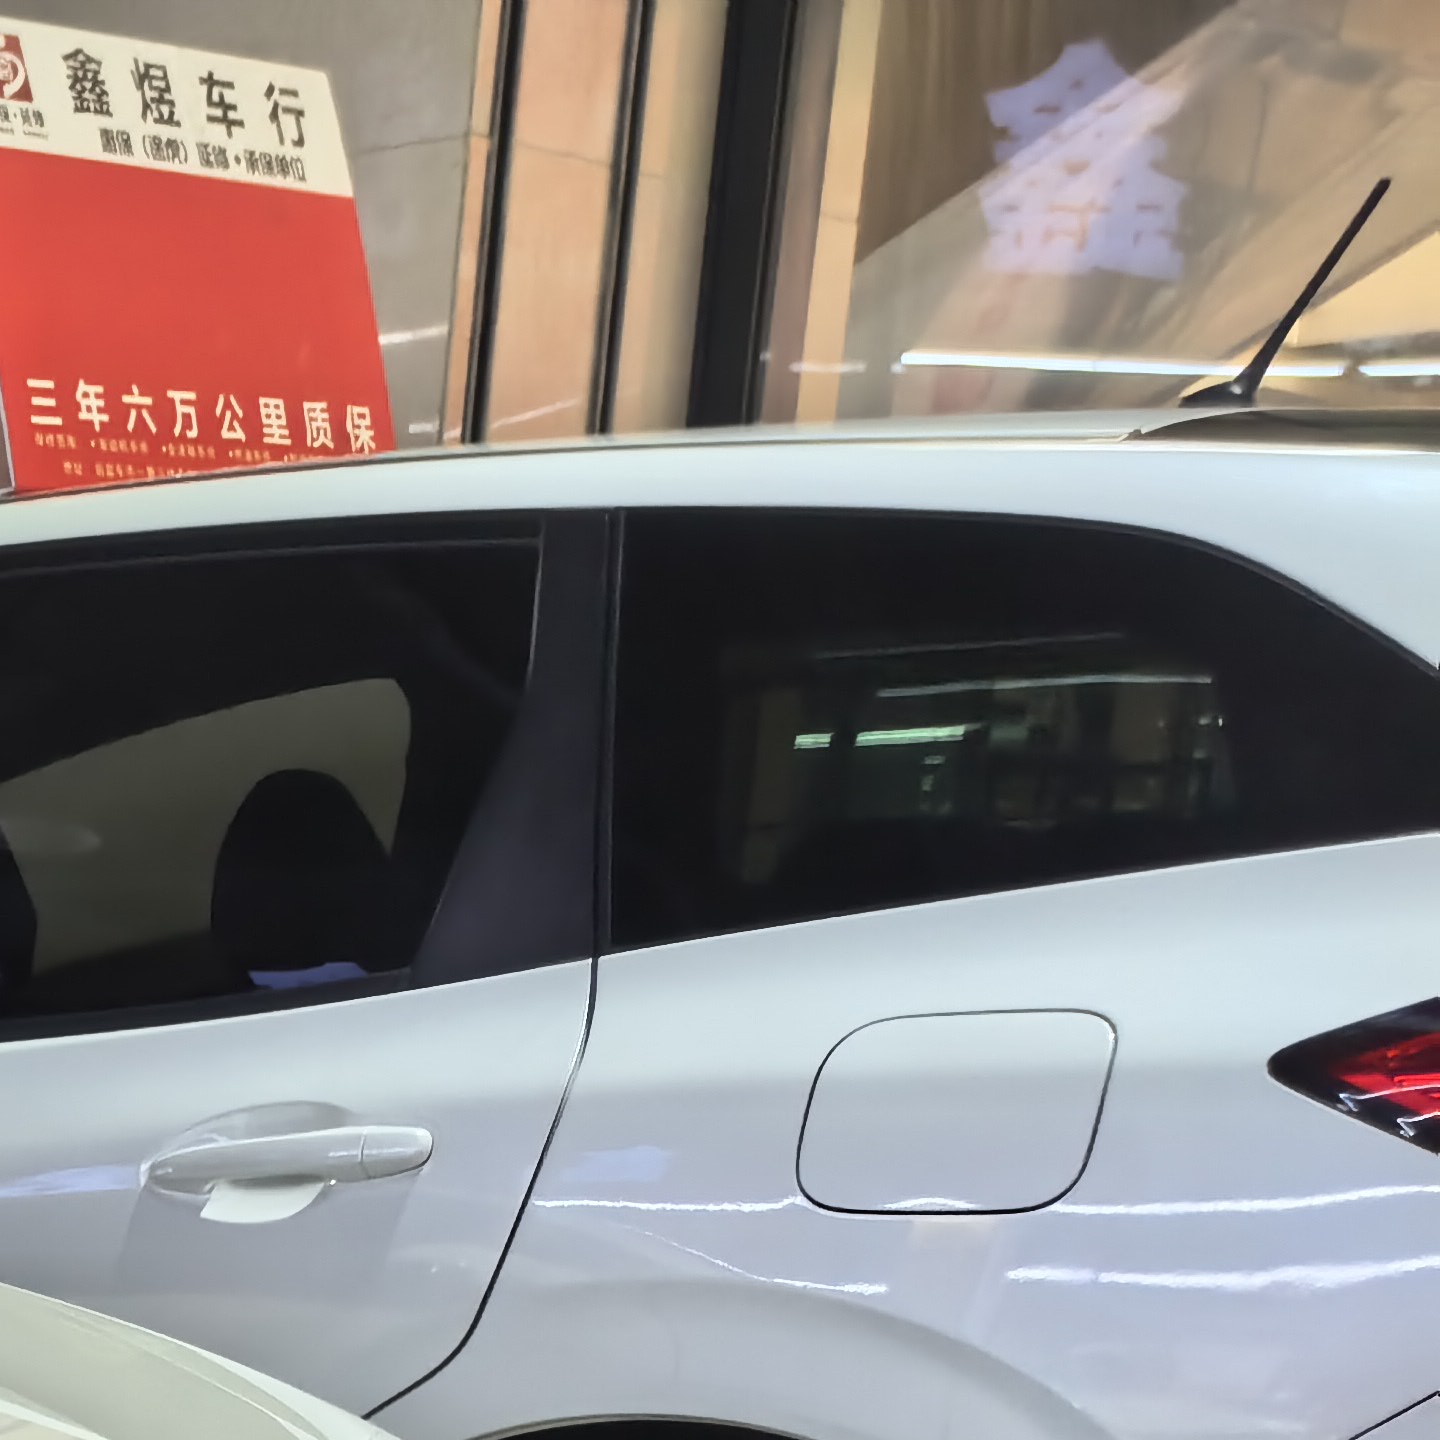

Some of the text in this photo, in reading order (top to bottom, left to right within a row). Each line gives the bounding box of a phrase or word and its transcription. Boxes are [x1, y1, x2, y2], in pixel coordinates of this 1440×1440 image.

[62, 48, 305, 148] 鑫煜车行
[26, 378, 376, 455] 三年六万公里质保
